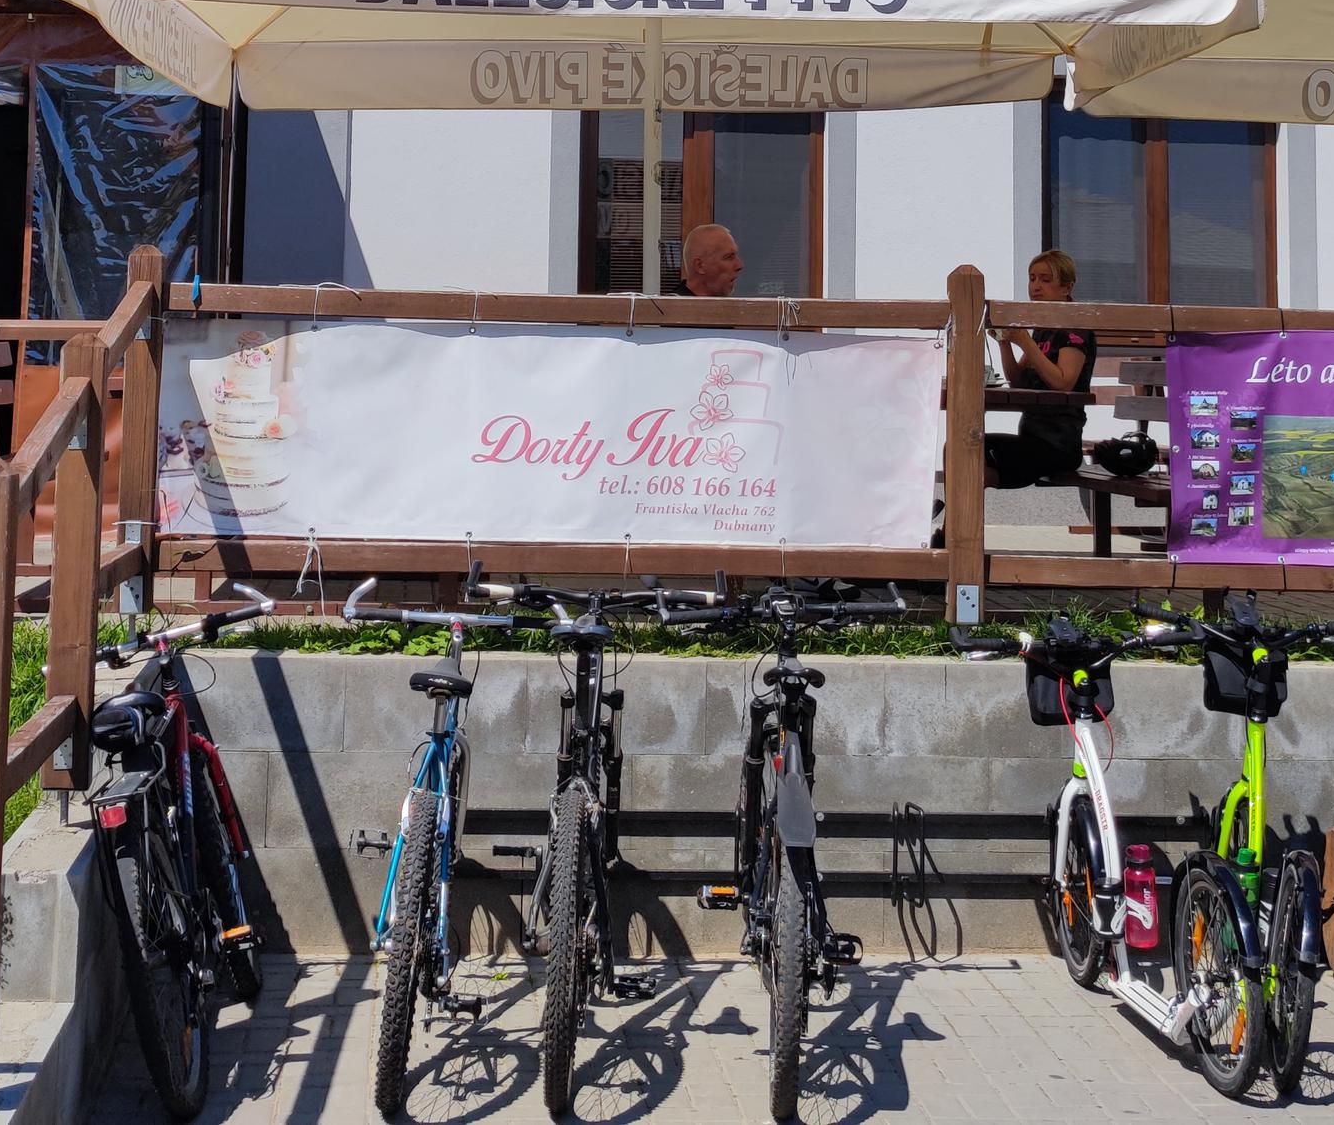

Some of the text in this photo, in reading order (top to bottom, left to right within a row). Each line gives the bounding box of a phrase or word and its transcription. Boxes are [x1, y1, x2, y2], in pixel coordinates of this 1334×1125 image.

[1245, 355, 1312, 384] Léto
[471, 408, 705, 481] Dorty Iva
[598, 474, 777, 498] tel.: 608 166 164
[703, 503, 748, 517] Vlacha
[753, 505, 776, 517] 762
